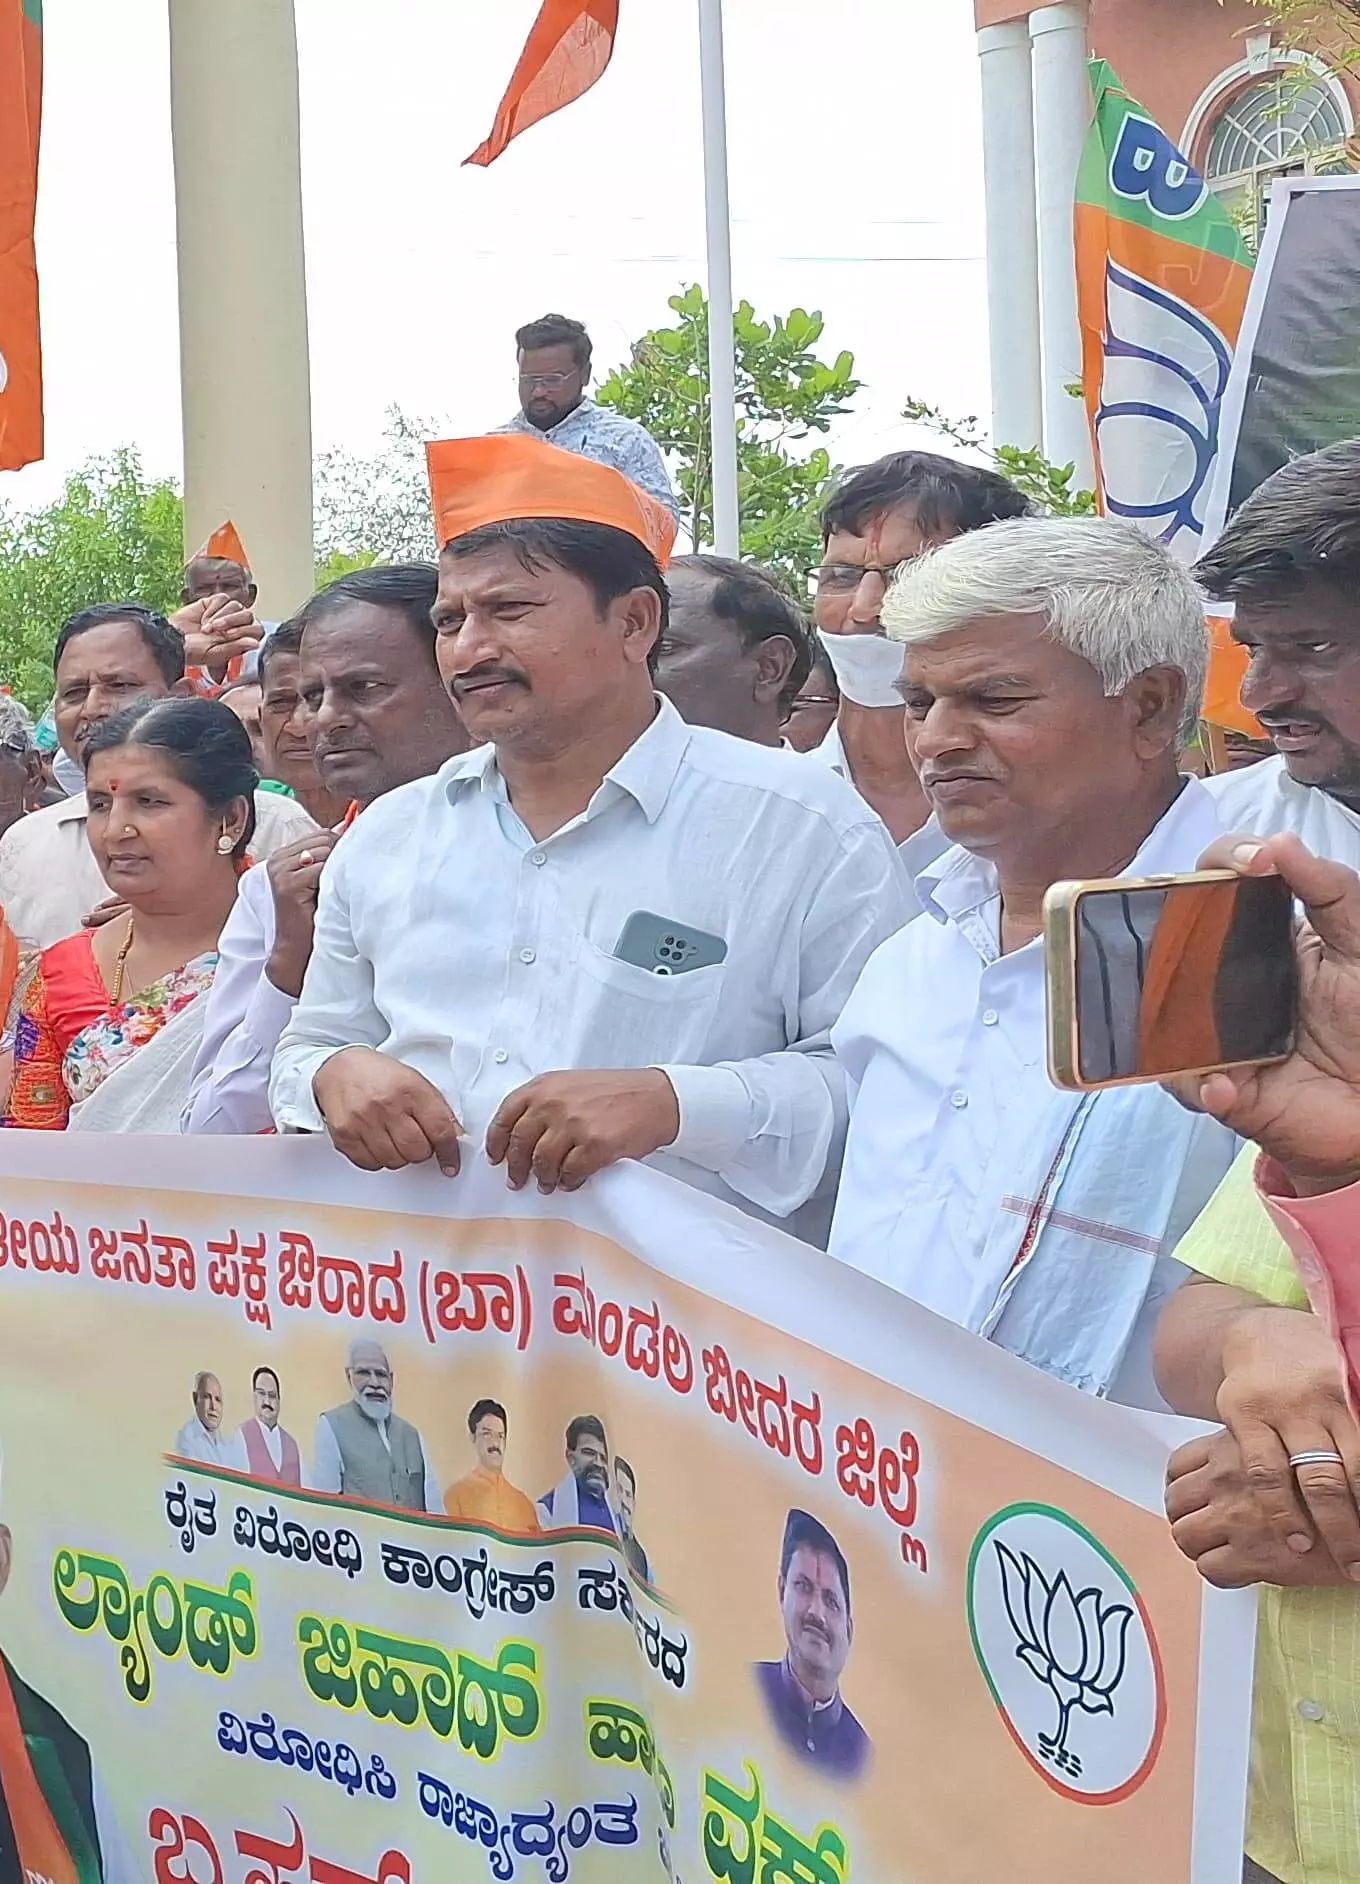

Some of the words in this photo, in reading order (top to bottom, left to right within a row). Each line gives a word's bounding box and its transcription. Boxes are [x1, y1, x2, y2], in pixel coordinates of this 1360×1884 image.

[88, 1221, 197, 1292] ಜನತಾ
[207, 1230, 271, 1329] ಪಕ್ಷ
[278, 1231, 406, 1324] ಔರಾದ
[702, 1345, 824, 1476] ಬೀದರ
[835, 1416, 928, 1573] ಜಿಲ್ಲೆ
[164, 1482, 218, 1553] ರೈತ
[233, 1505, 363, 1577] ವಿರೋಧಿ
[53, 1548, 253, 1703] ಲ್ಯಾಂಡ್
[299, 1615, 540, 1758] ಜಿಹಾದ್
[217, 1711, 397, 1800] ವಿರೋಧಿಸಿ
[417, 1770, 639, 1883] ರಾಜ್ಯಾದ್ಯಂತ
